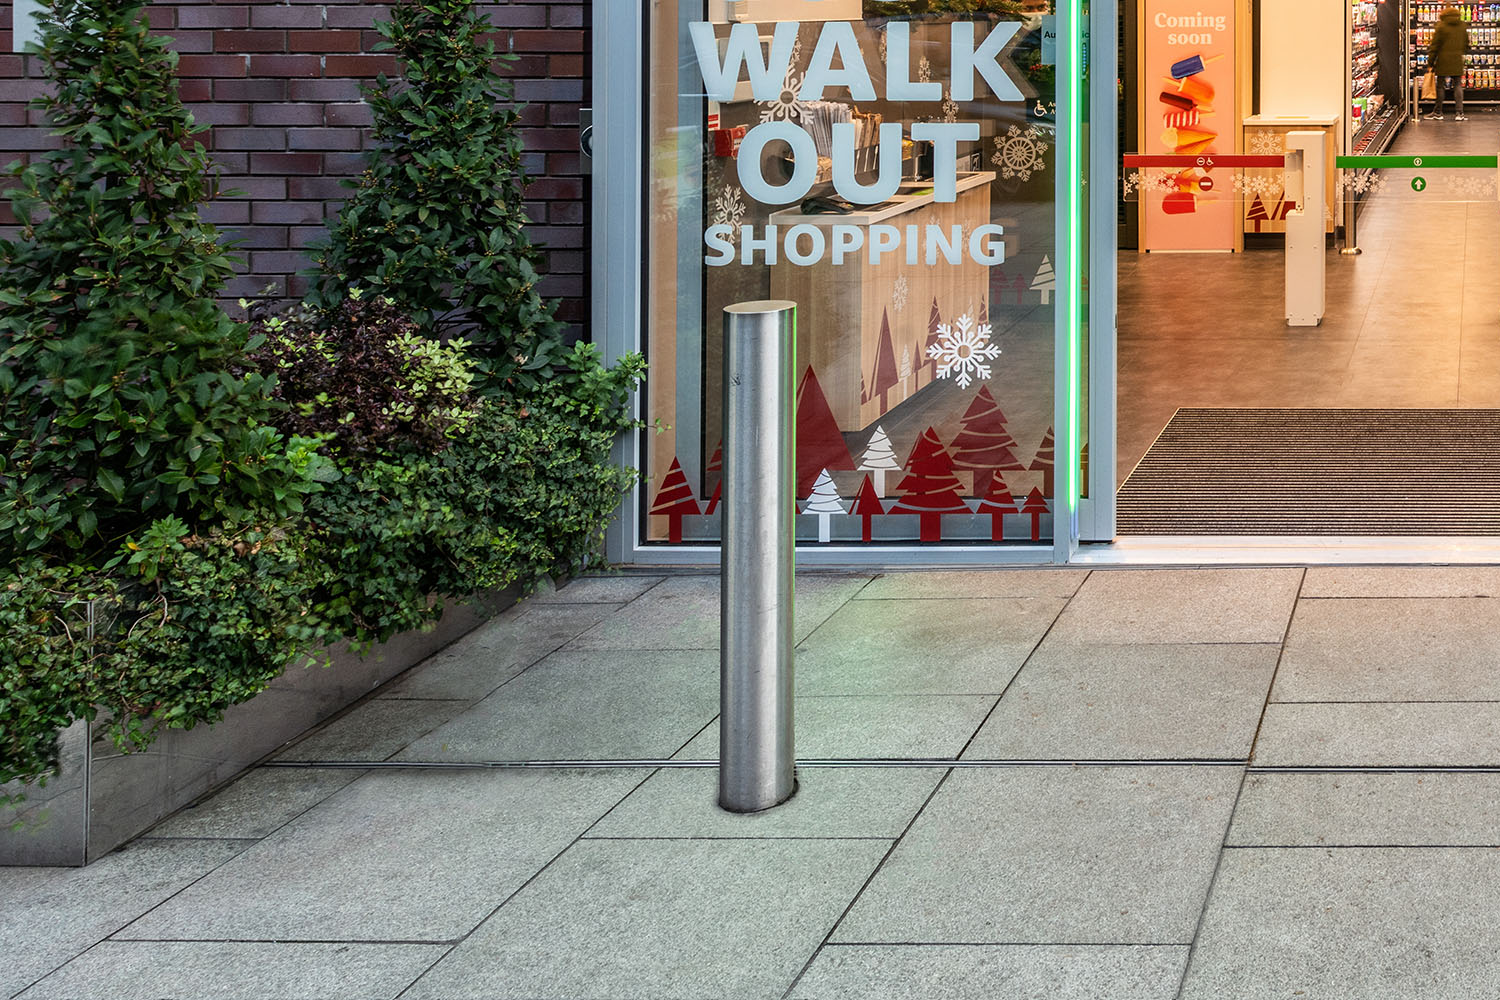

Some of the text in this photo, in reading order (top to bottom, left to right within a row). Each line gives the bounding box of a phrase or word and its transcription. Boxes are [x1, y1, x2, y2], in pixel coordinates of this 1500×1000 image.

[1154, 11, 1226, 31] Coming
[1167, 33, 1212, 45] soon
[688, 21, 1025, 102] WALK
[736, 122, 980, 205] OUT
[703, 223, 1005, 266] SHOPPING
